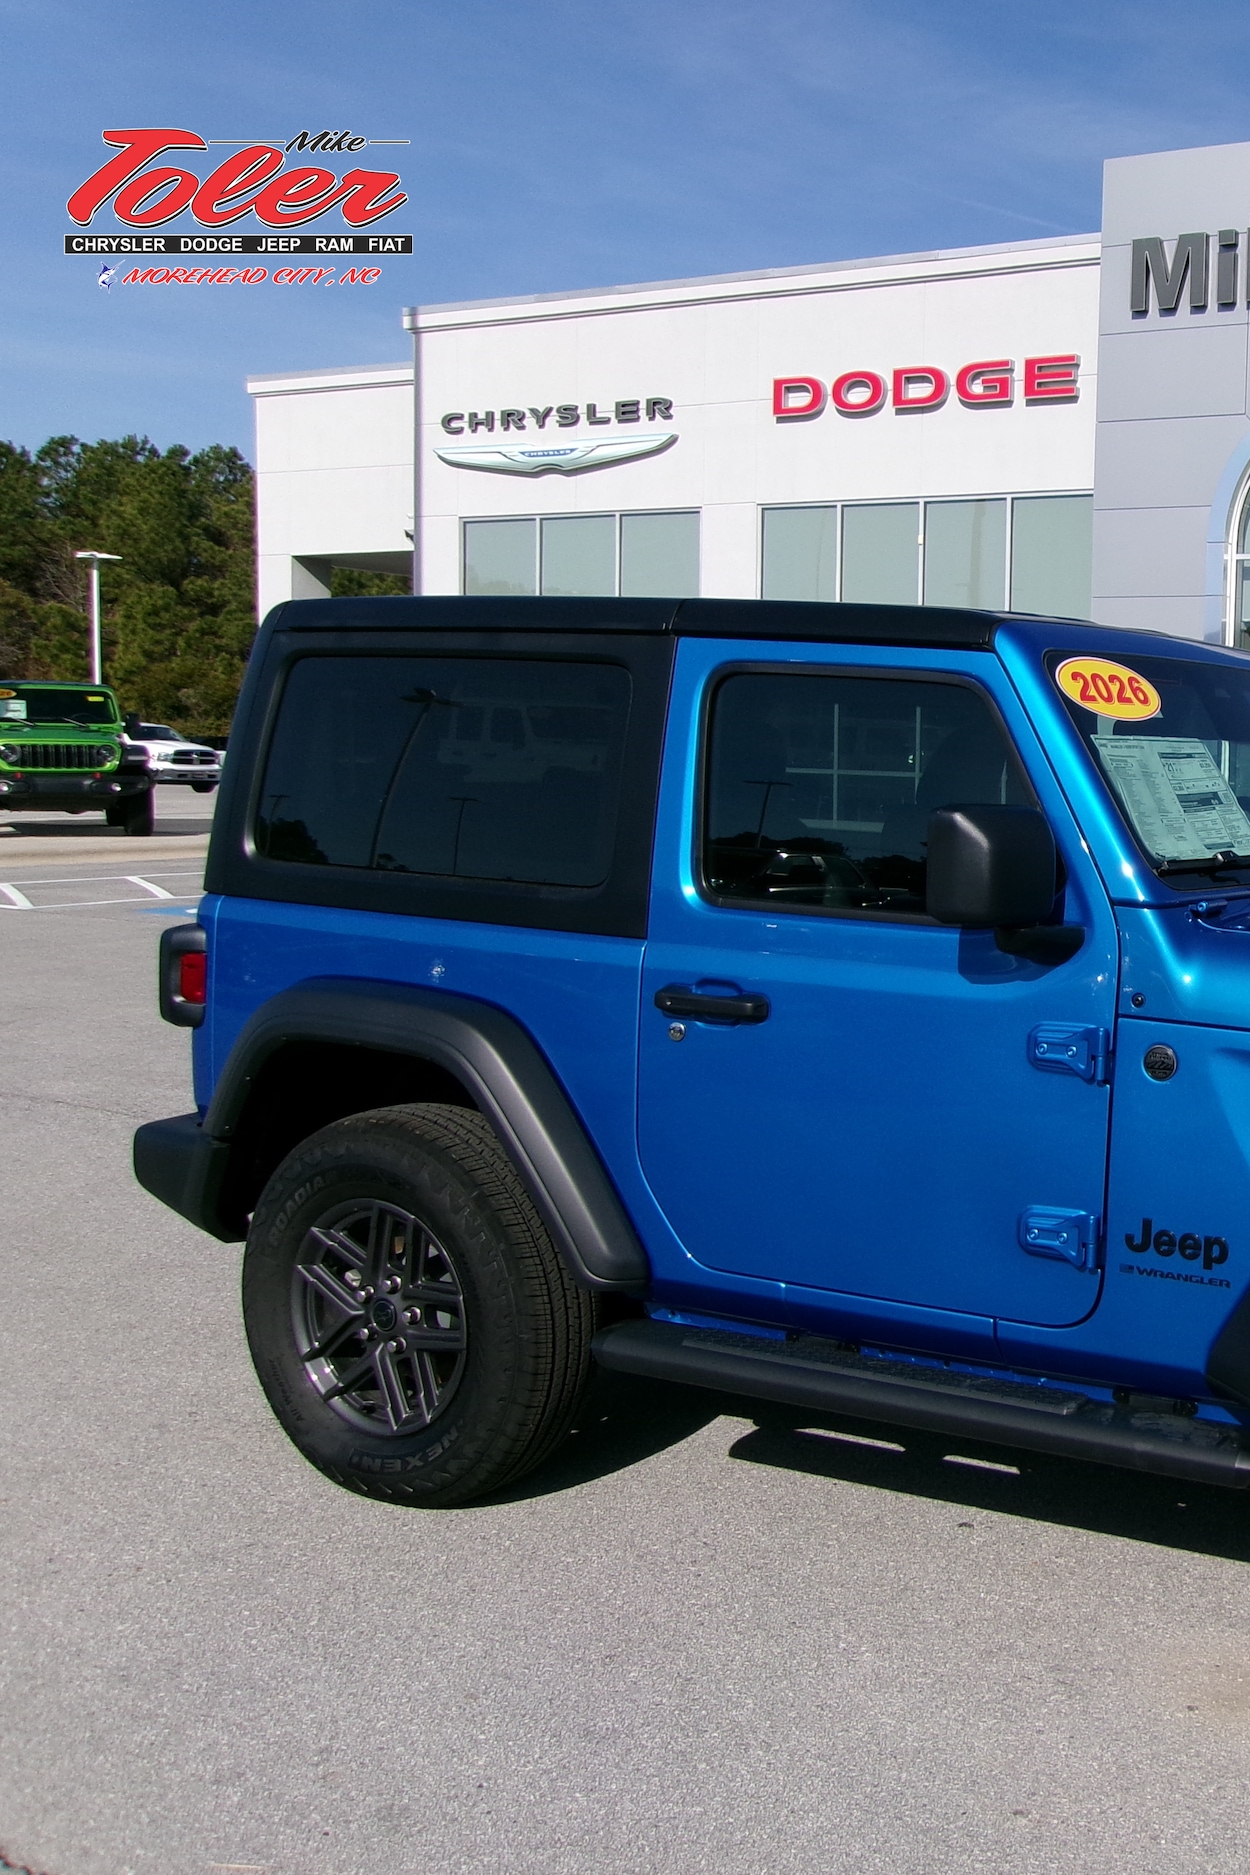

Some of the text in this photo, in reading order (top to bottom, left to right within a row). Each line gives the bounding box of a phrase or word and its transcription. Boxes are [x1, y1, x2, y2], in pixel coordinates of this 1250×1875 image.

[772, 354, 1081, 425] DODGE
[440, 397, 674, 435] CHRYSLER
[525, 449, 571, 457] CHRYSLER
[1071, 671, 1151, 707] 2026
[1125, 1218, 1229, 1270] Jeep
[1136, 1265, 1232, 1289] WRANGLER
